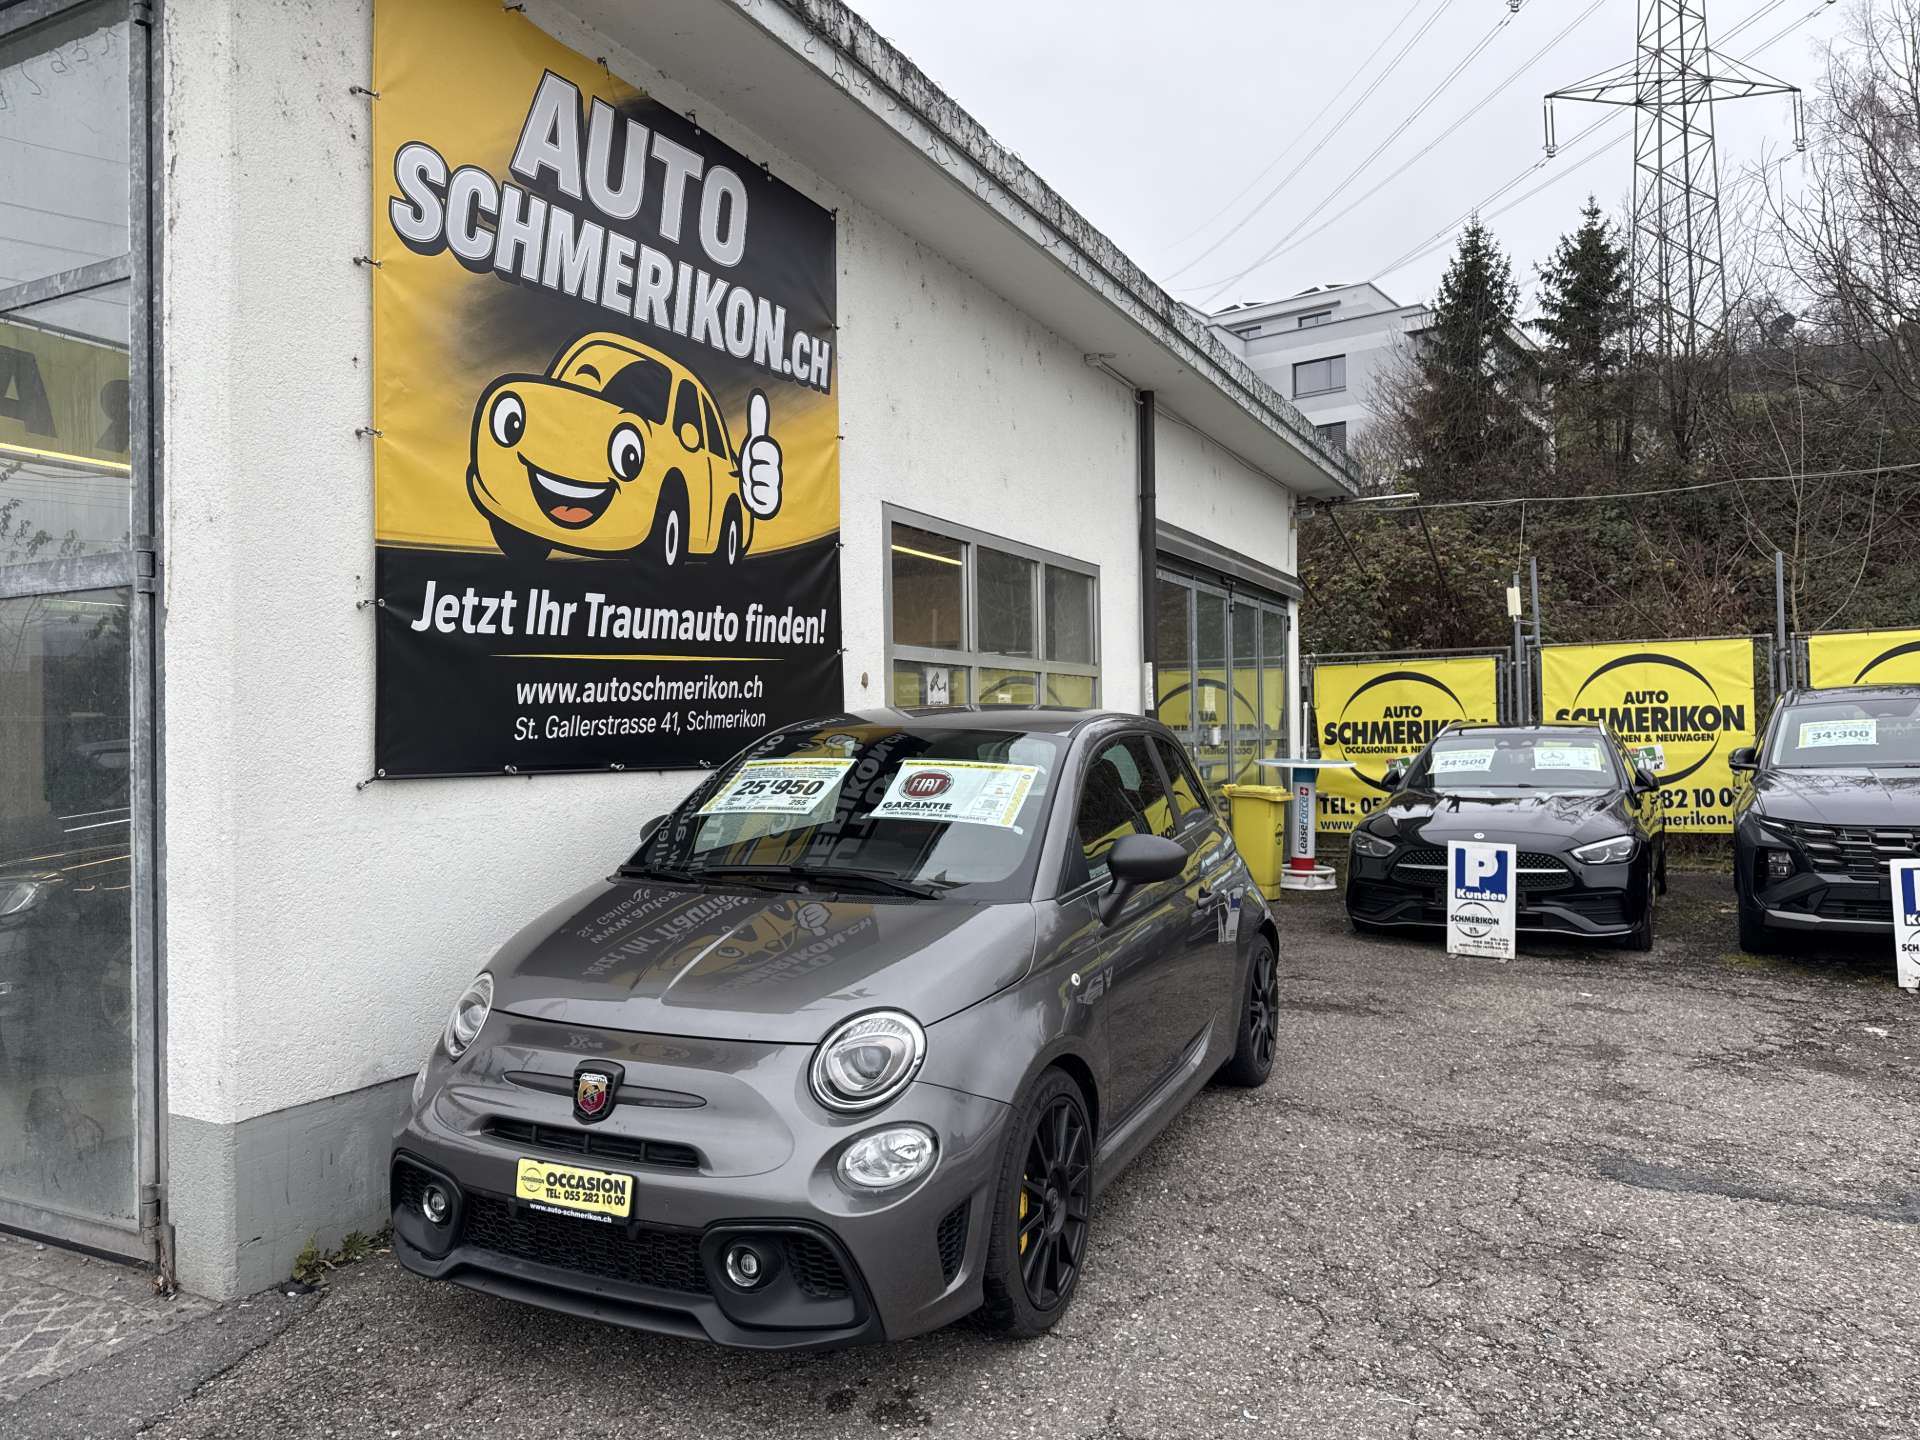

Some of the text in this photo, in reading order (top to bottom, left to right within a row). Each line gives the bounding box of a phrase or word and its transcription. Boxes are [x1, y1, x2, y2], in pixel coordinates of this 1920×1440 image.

[510, 70, 748, 267] AUTO
[390, 142, 831, 389] SCHMERIKON.CH
[411, 580, 827, 644] Jetzt Ihr Traumauto finden!
[516, 675, 763, 705] www.autoschmerikon.ch
[1624, 690, 1669, 705] AUTO
[1383, 705, 1423, 719] AUTO
[514, 716, 539, 741] St.
[545, 714, 657, 739] Gallerstrasse
[661, 711, 681, 736] 41,
[686, 709, 766, 731] Schmerikon
[1656, 733, 1715, 743] NEUWAGEN
[1345, 745, 1398, 754] OCCASIONEN
[732, 780, 824, 796] 25'950
[909, 777, 944, 792] FIAT
[882, 801, 952, 810] GARANTIE
[1320, 797, 1356, 815] TEL:
[1693, 788, 1715, 808] 10
[1719, 788, 1733, 807] 0
[1298, 796, 1308, 855] LeaseForce
[1465, 849, 1499, 888] P
[1457, 888, 1506, 902] Kunden
[1450, 914, 1499, 925] SCHMERIKON
[1902, 944, 1920, 952] SCH
[546, 1172, 626, 1195] OCCASION
[546, 1188, 626, 1206] TEL: 055 282 10 00
[529, 1202, 612, 1223] www.auto-schmerikon.ch
